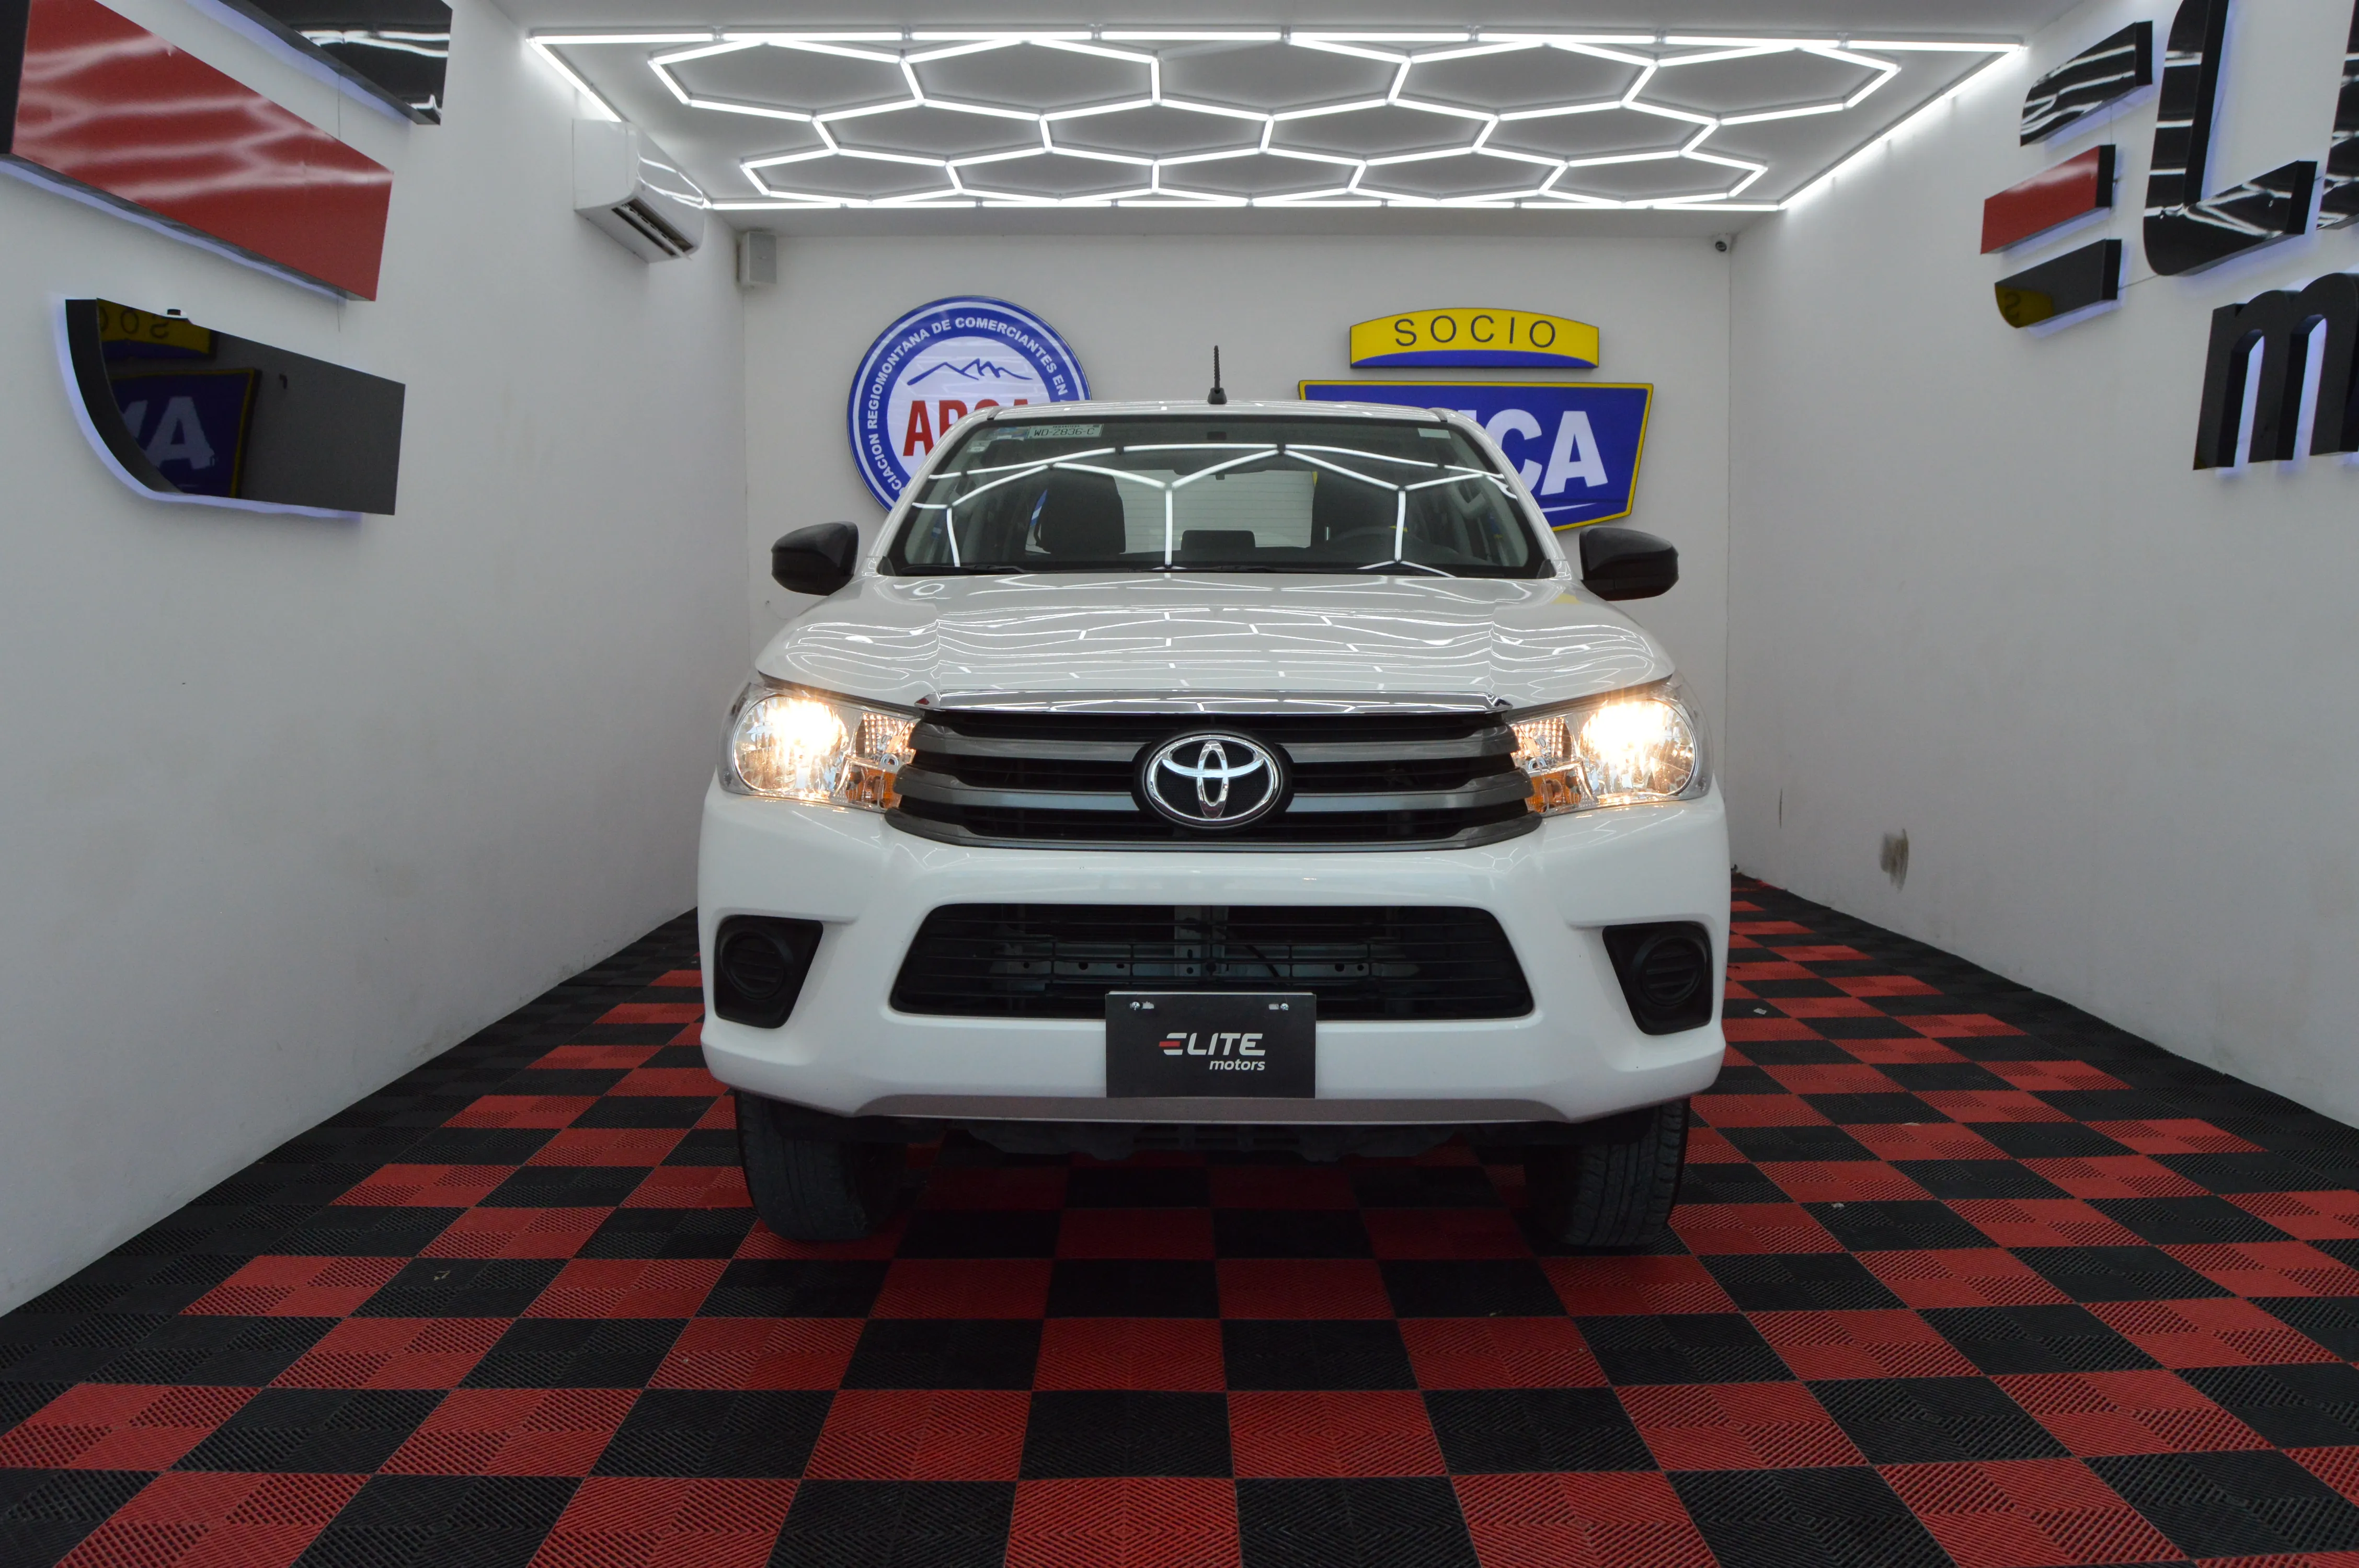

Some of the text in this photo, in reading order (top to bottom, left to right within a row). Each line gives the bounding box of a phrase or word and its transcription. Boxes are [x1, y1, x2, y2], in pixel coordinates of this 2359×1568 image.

[1394, 315, 1556, 348] SOCIO
[867, 317, 1068, 496] CIACION REGIOMONTANA DE COMERCIANTES EN
[1159, 1032, 1266, 1056] ELITE
[1209, 1059, 1266, 1071] motors
